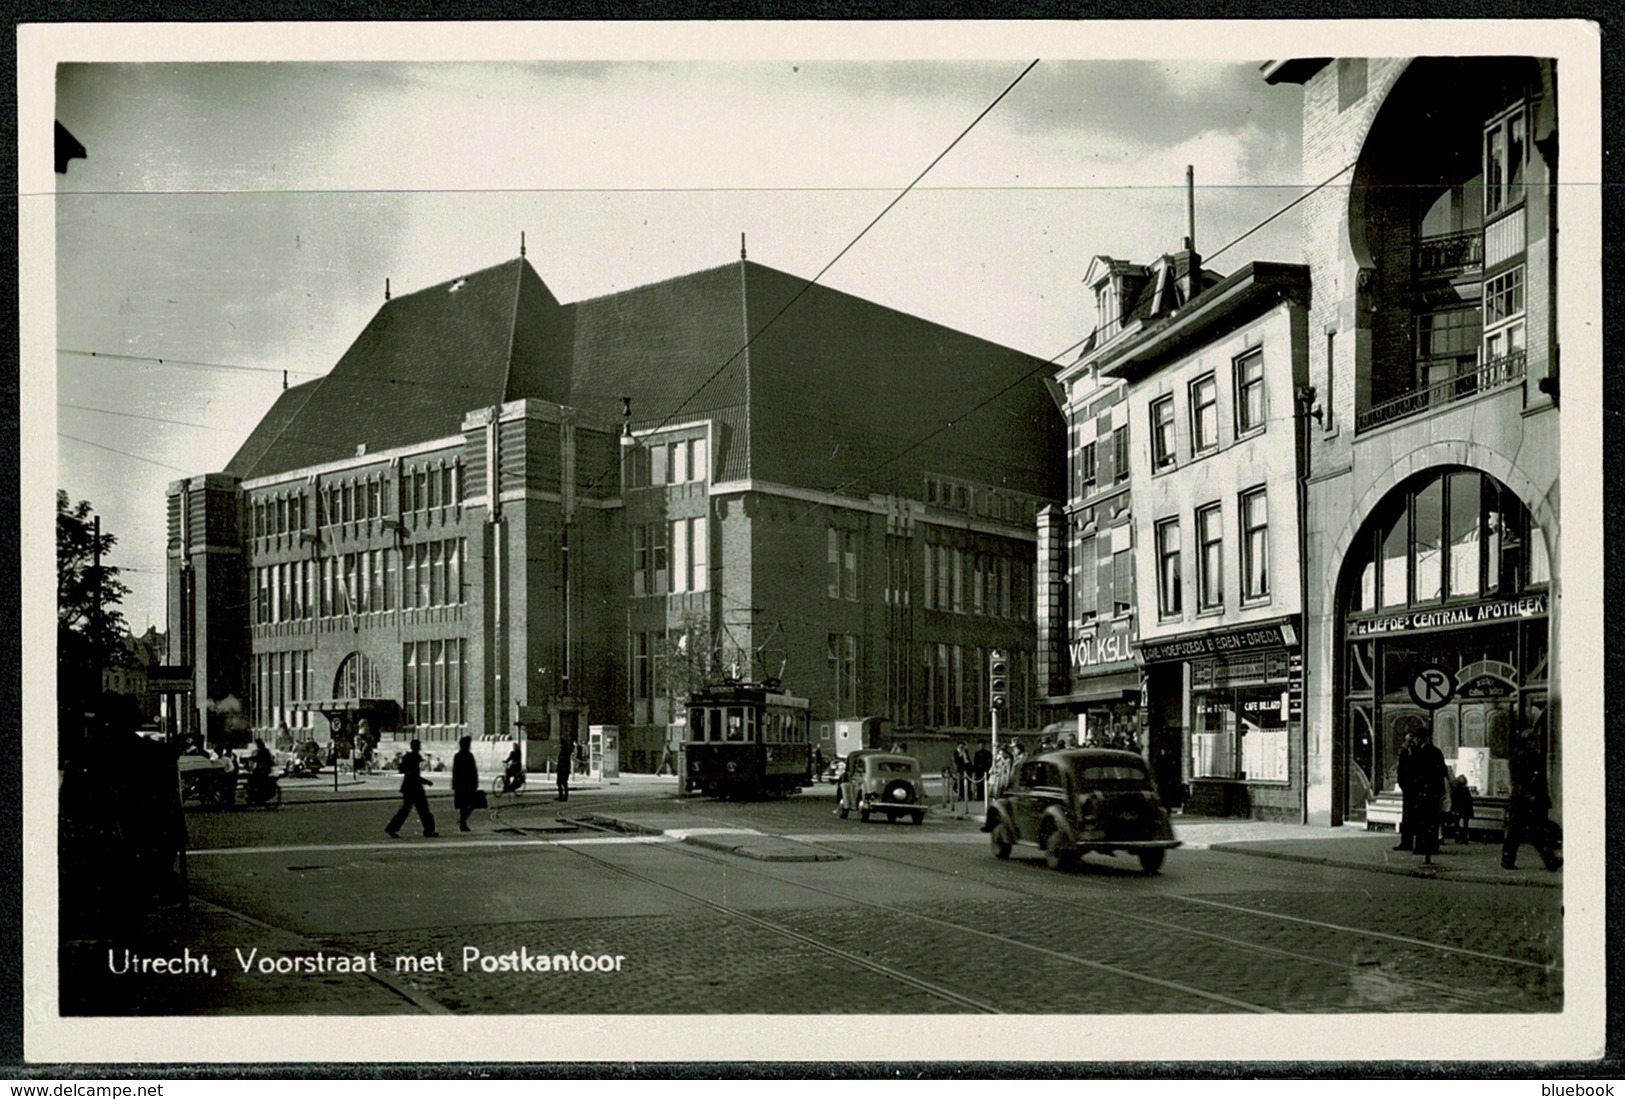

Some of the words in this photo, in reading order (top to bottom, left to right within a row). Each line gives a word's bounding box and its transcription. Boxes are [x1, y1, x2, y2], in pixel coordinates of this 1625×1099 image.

[1413, 609, 1473, 628] CENTRAAL
[1477, 599, 1544, 620] APOTHEEK
[1206, 634, 1241, 652] BEREN
[1246, 629, 1281, 646] BREDA
